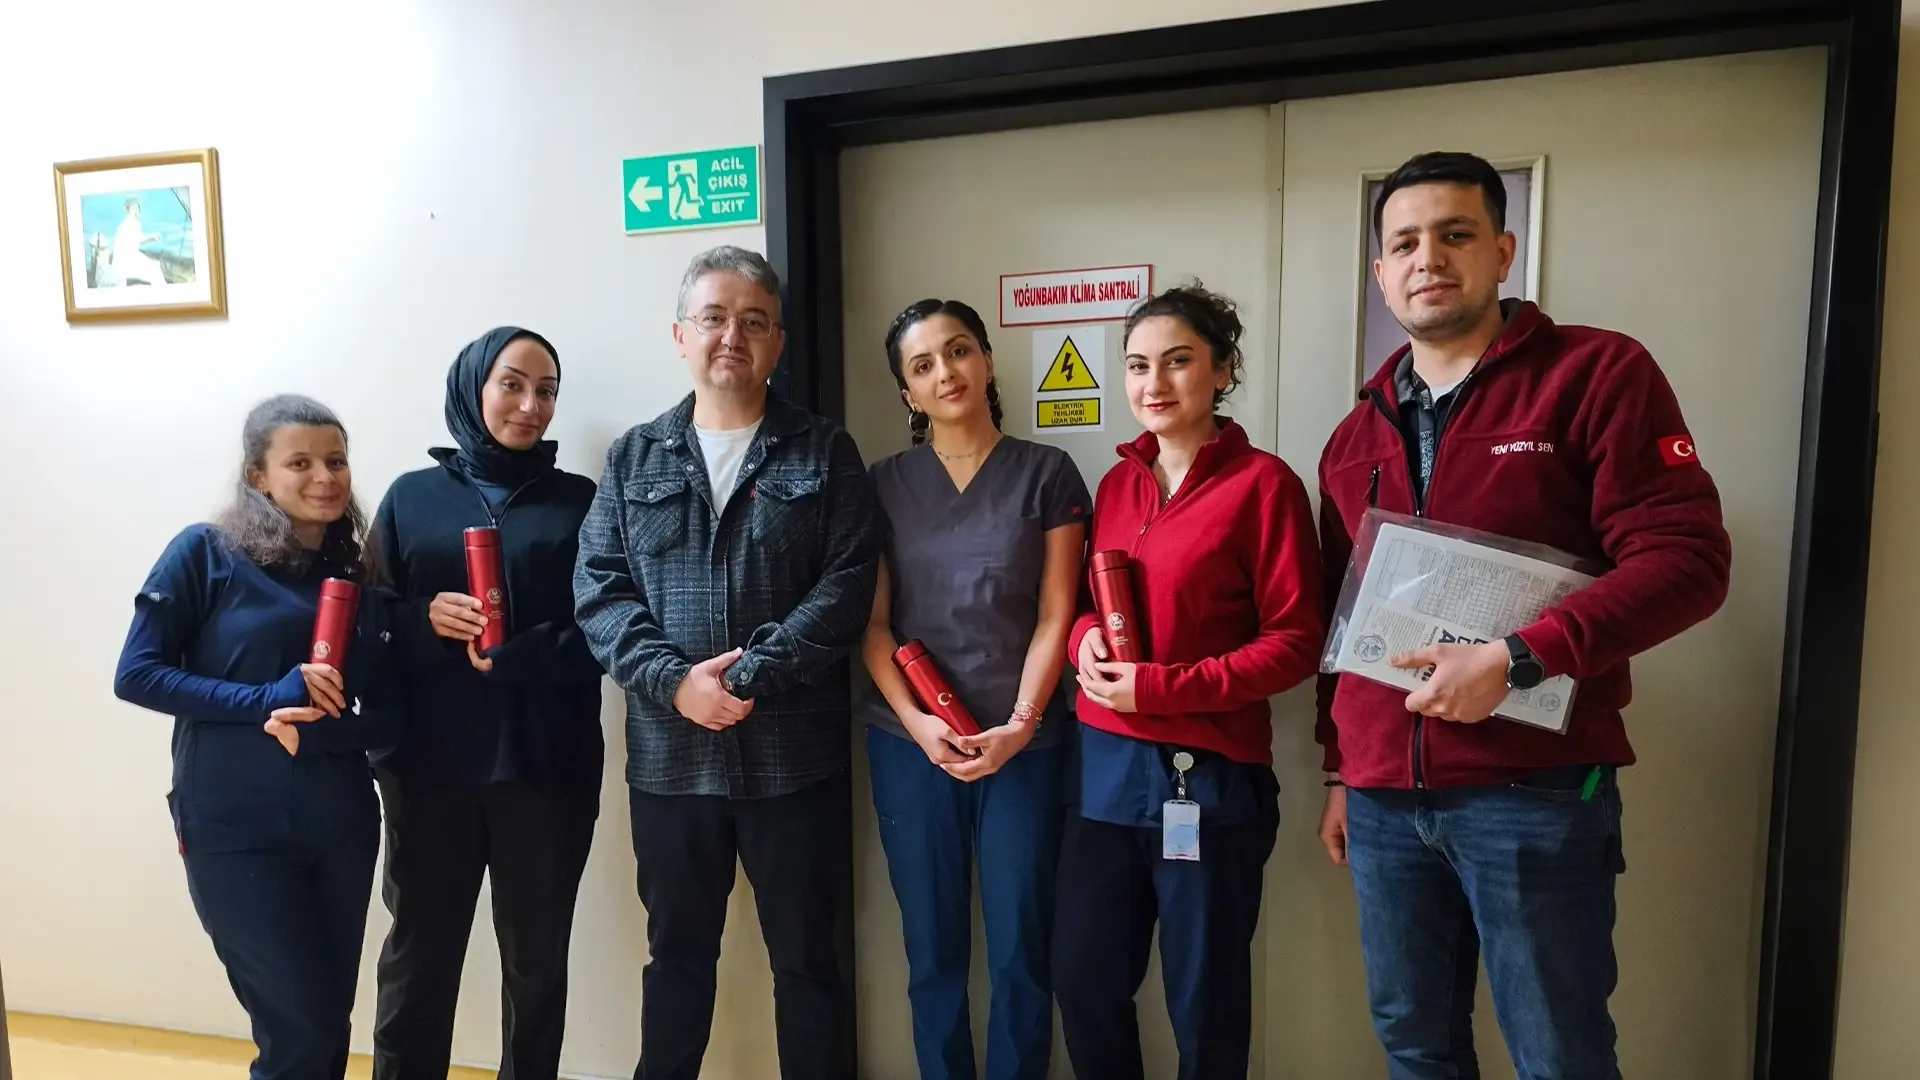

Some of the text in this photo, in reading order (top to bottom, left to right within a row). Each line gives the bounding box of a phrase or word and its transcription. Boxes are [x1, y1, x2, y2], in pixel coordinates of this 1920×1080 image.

[711, 155, 744, 172] ACİL
[708, 173, 748, 192] ÇIKIŞ
[711, 199, 745, 214] EXIT
[1013, 274, 1140, 308] YOĞUNBAKIM KLİMA SANTRALİ
